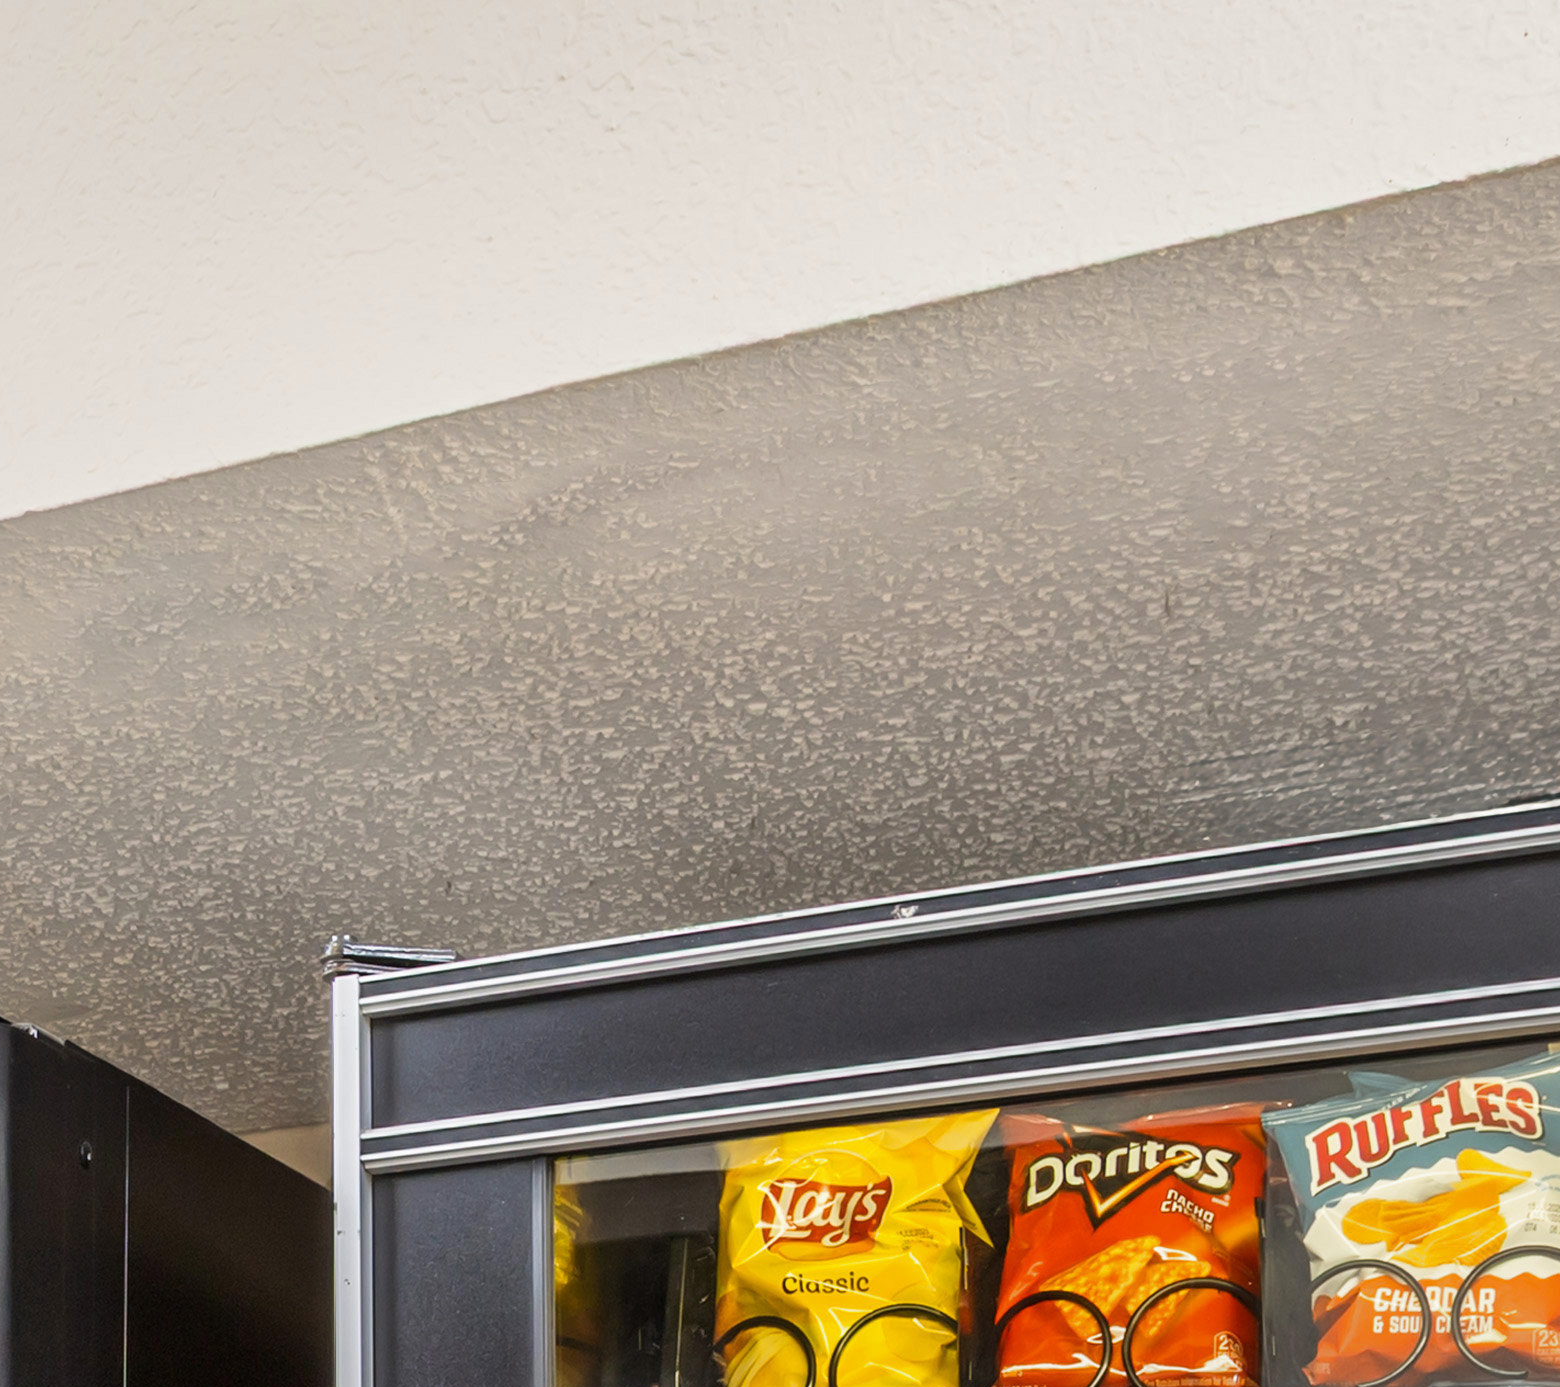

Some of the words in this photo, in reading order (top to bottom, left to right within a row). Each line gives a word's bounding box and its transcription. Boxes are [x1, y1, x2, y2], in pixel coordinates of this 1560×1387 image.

[1310, 1076, 1544, 1197] RUFFLES
[1025, 1140, 1237, 1209] Doritos
[762, 1175, 886, 1246] Lay's
[781, 1270, 870, 1296] Classic
